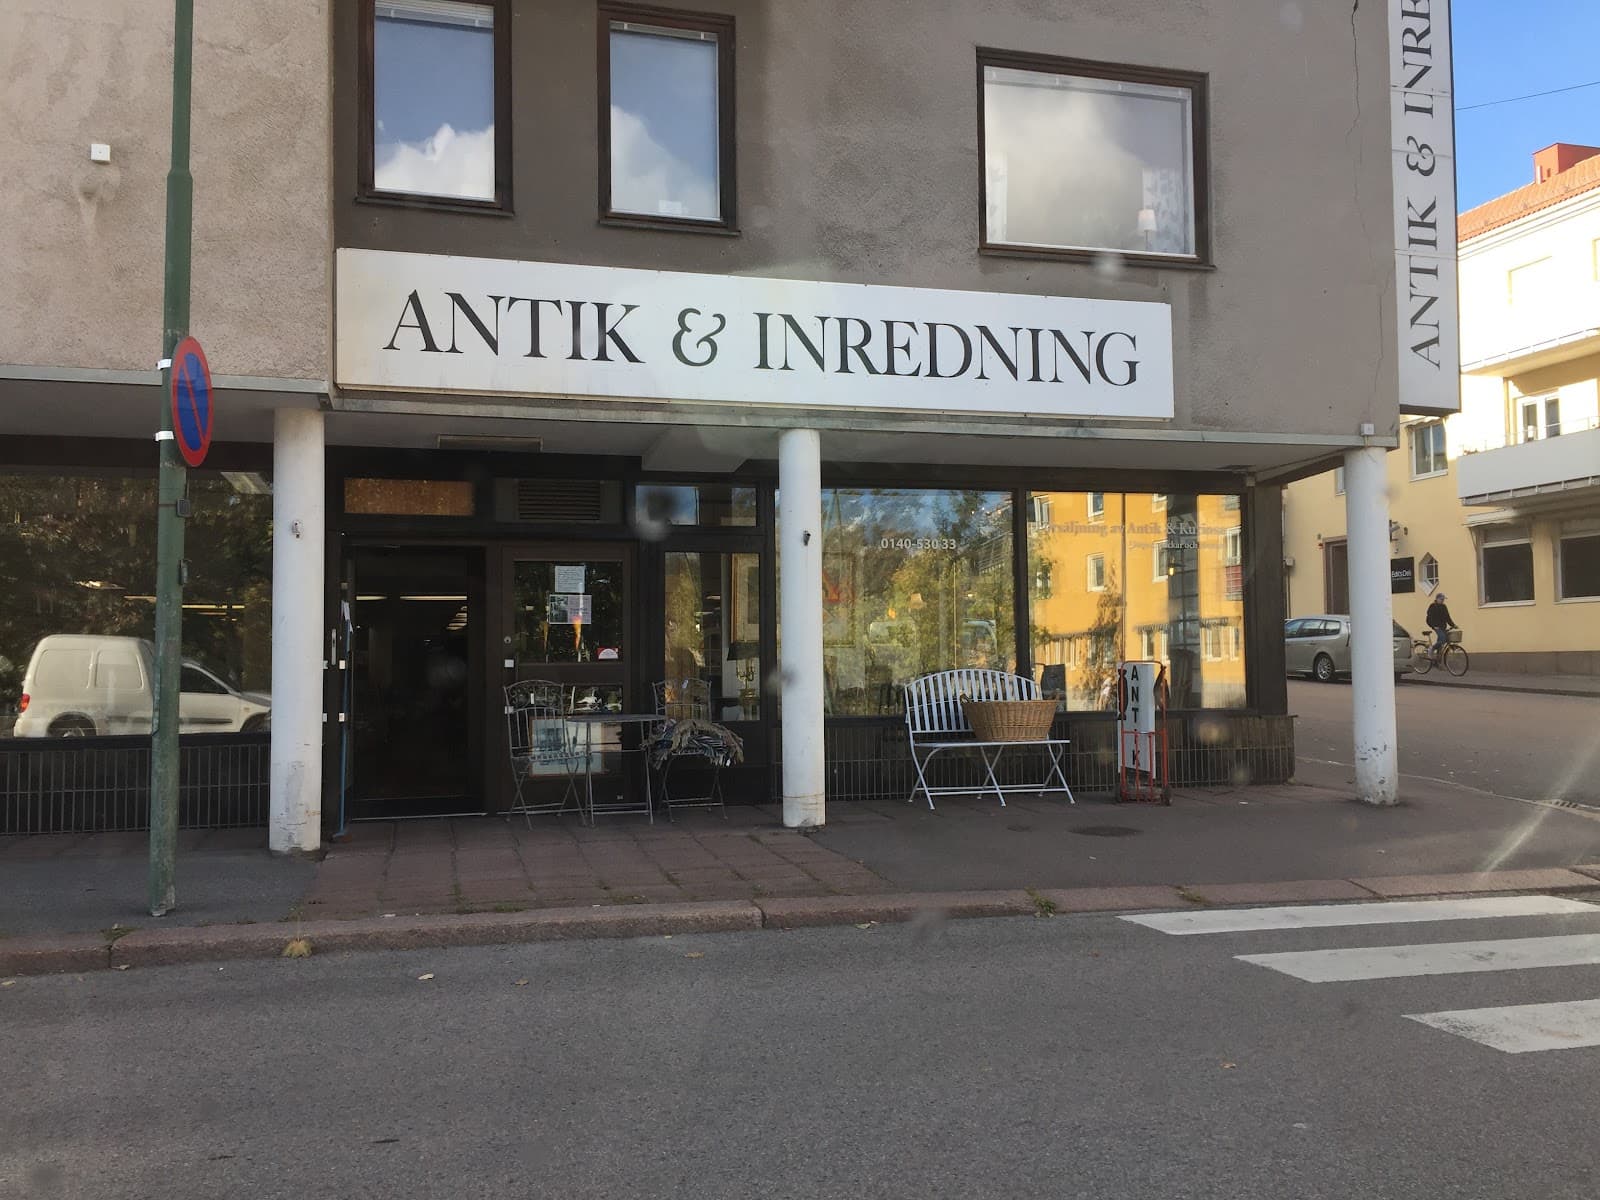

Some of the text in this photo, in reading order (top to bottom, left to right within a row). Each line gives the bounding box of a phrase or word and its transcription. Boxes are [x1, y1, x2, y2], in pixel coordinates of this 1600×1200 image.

[1406, 135, 1436, 177] &
[1407, 199, 1441, 368] ANTIK
[382, 289, 1139, 387] ANTIK & INREDNING
[941, 539, 956, 549] 33
[1131, 665, 1140, 766] ANTIK
